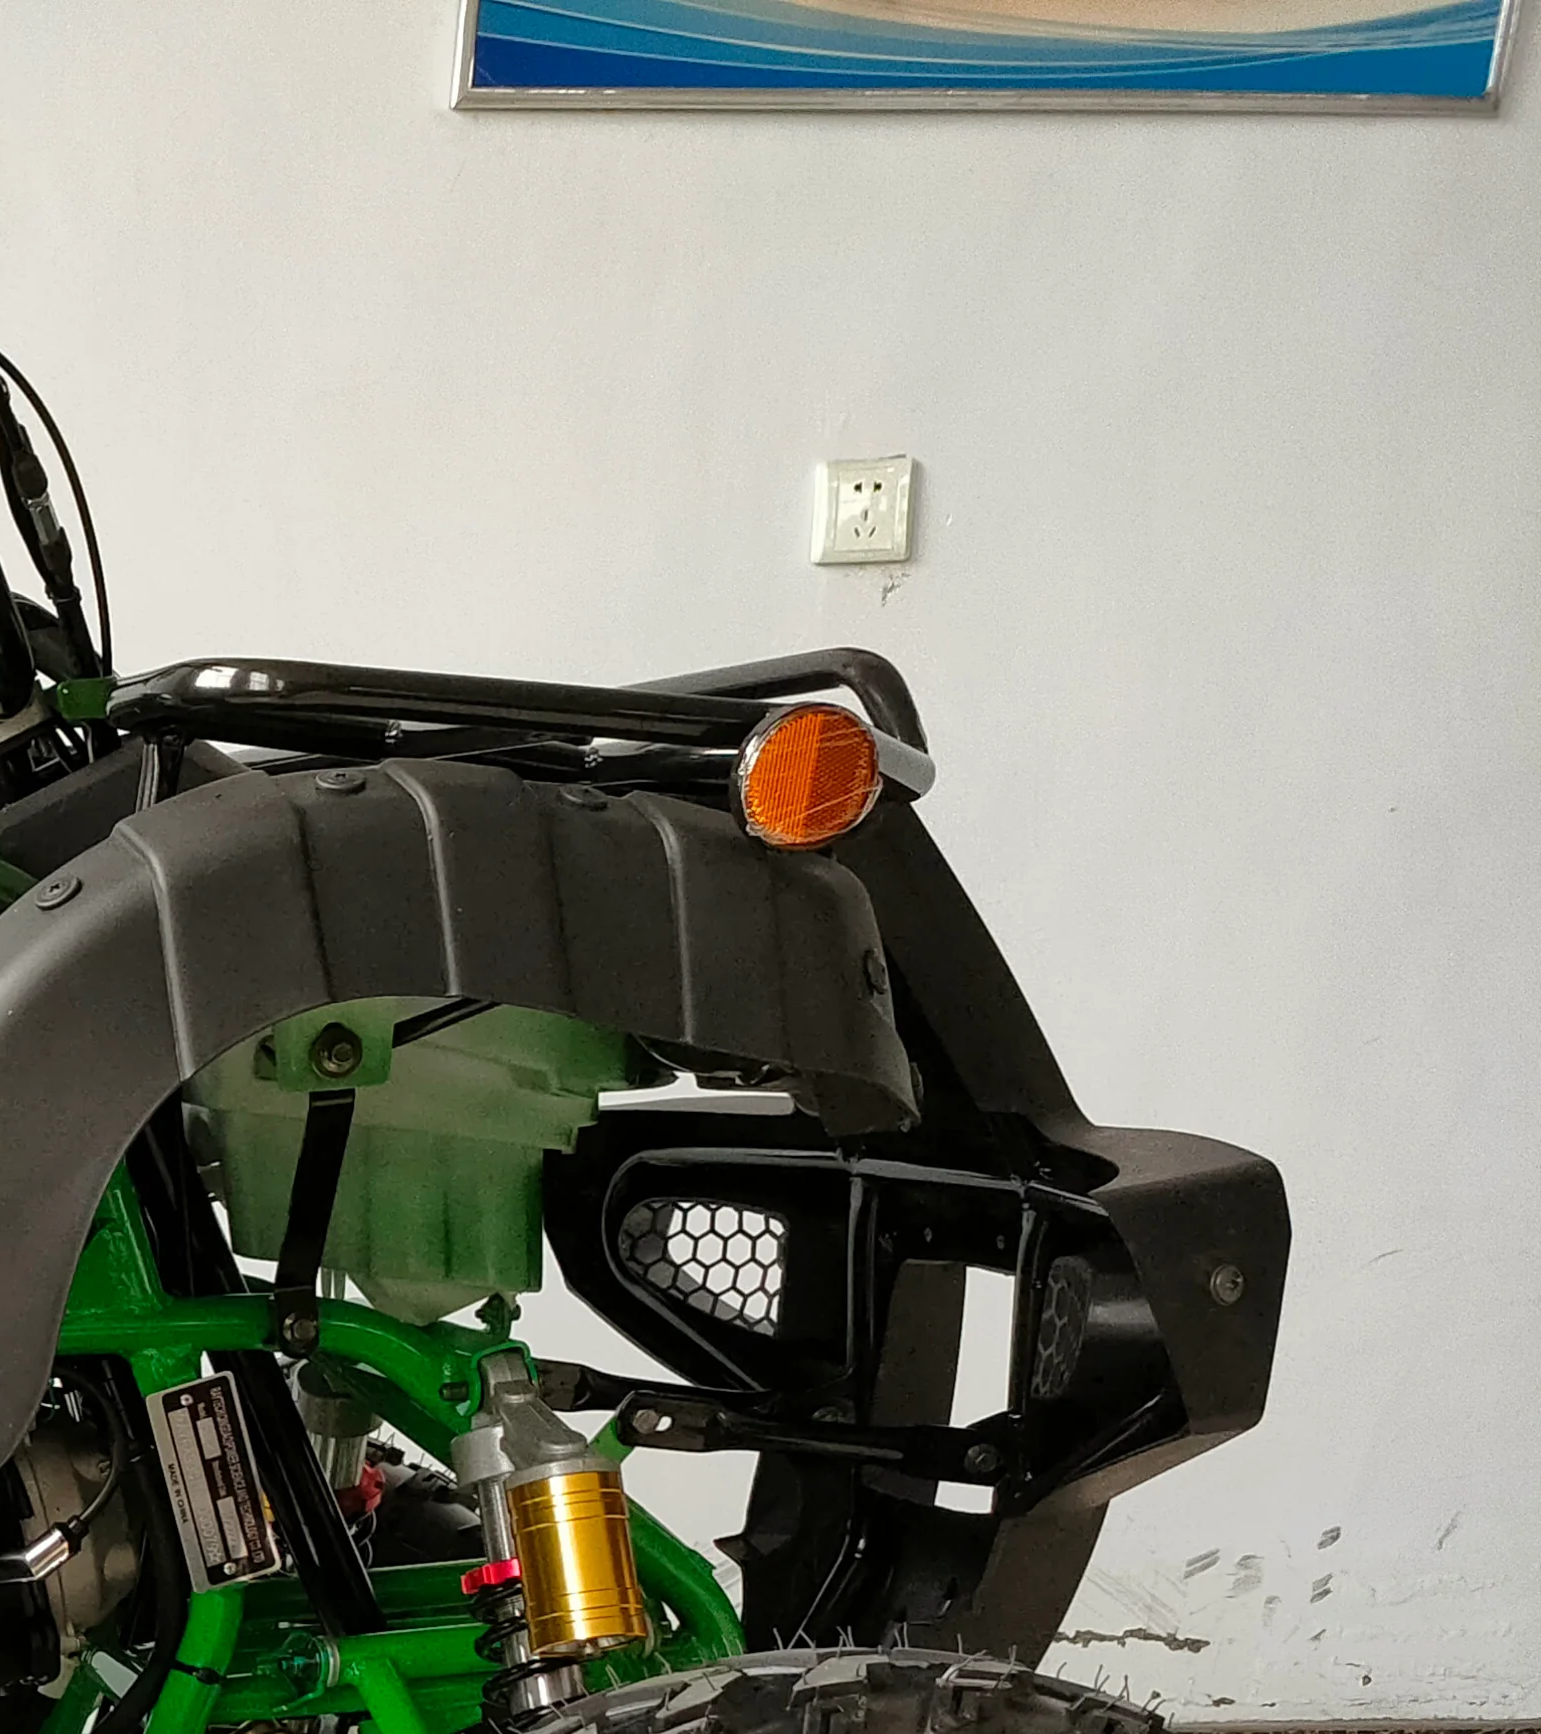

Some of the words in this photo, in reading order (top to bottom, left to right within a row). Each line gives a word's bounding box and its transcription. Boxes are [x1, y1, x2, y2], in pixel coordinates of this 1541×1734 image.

[166, 1462, 179, 1486] MADE
[173, 1488, 182, 1497] IN
[176, 1498, 188, 1524] CHINA
